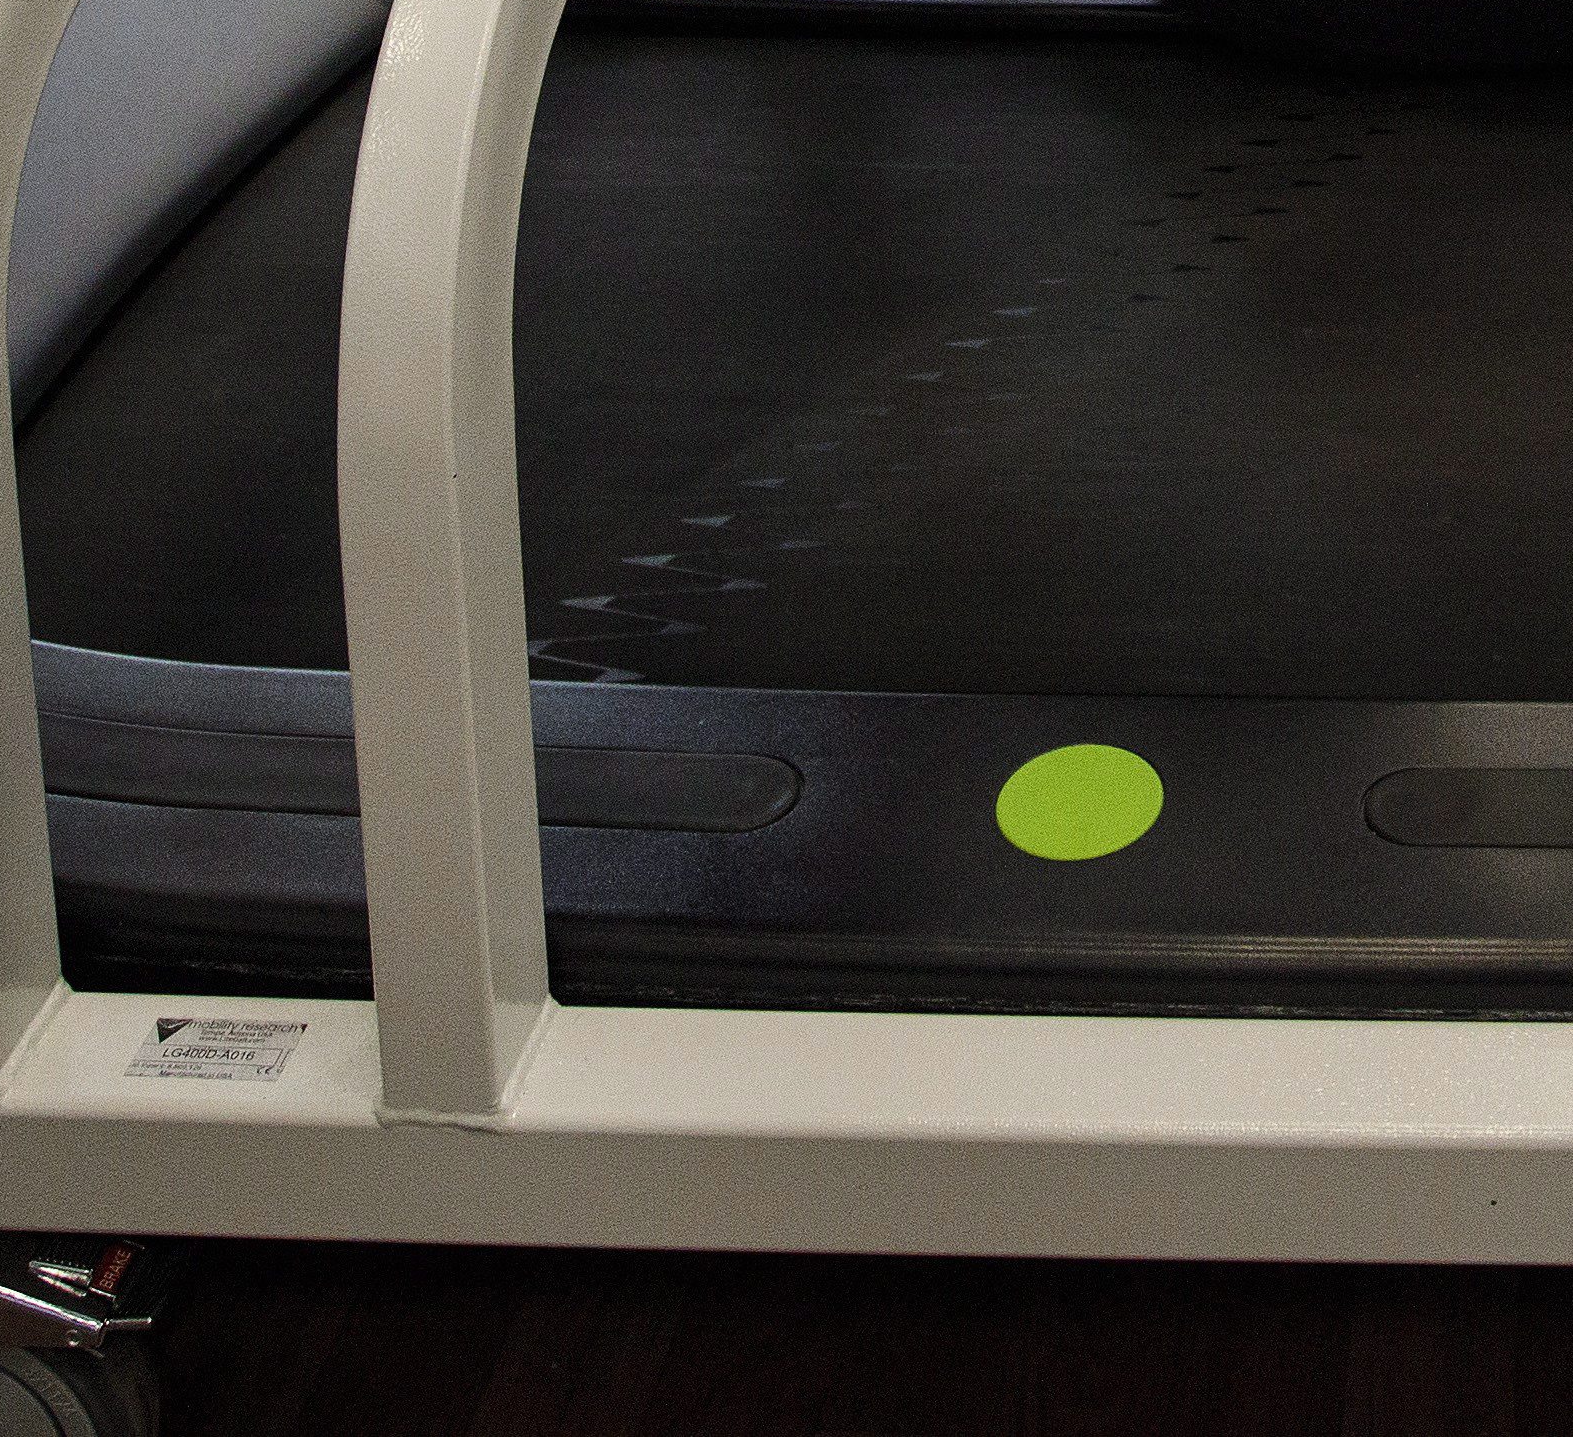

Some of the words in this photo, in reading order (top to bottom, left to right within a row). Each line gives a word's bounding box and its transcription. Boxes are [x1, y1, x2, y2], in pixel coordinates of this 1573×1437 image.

[187, 1019, 241, 1034] mobility
[241, 1020, 299, 1034] research
[98, 1248, 133, 1290] BRAKE
